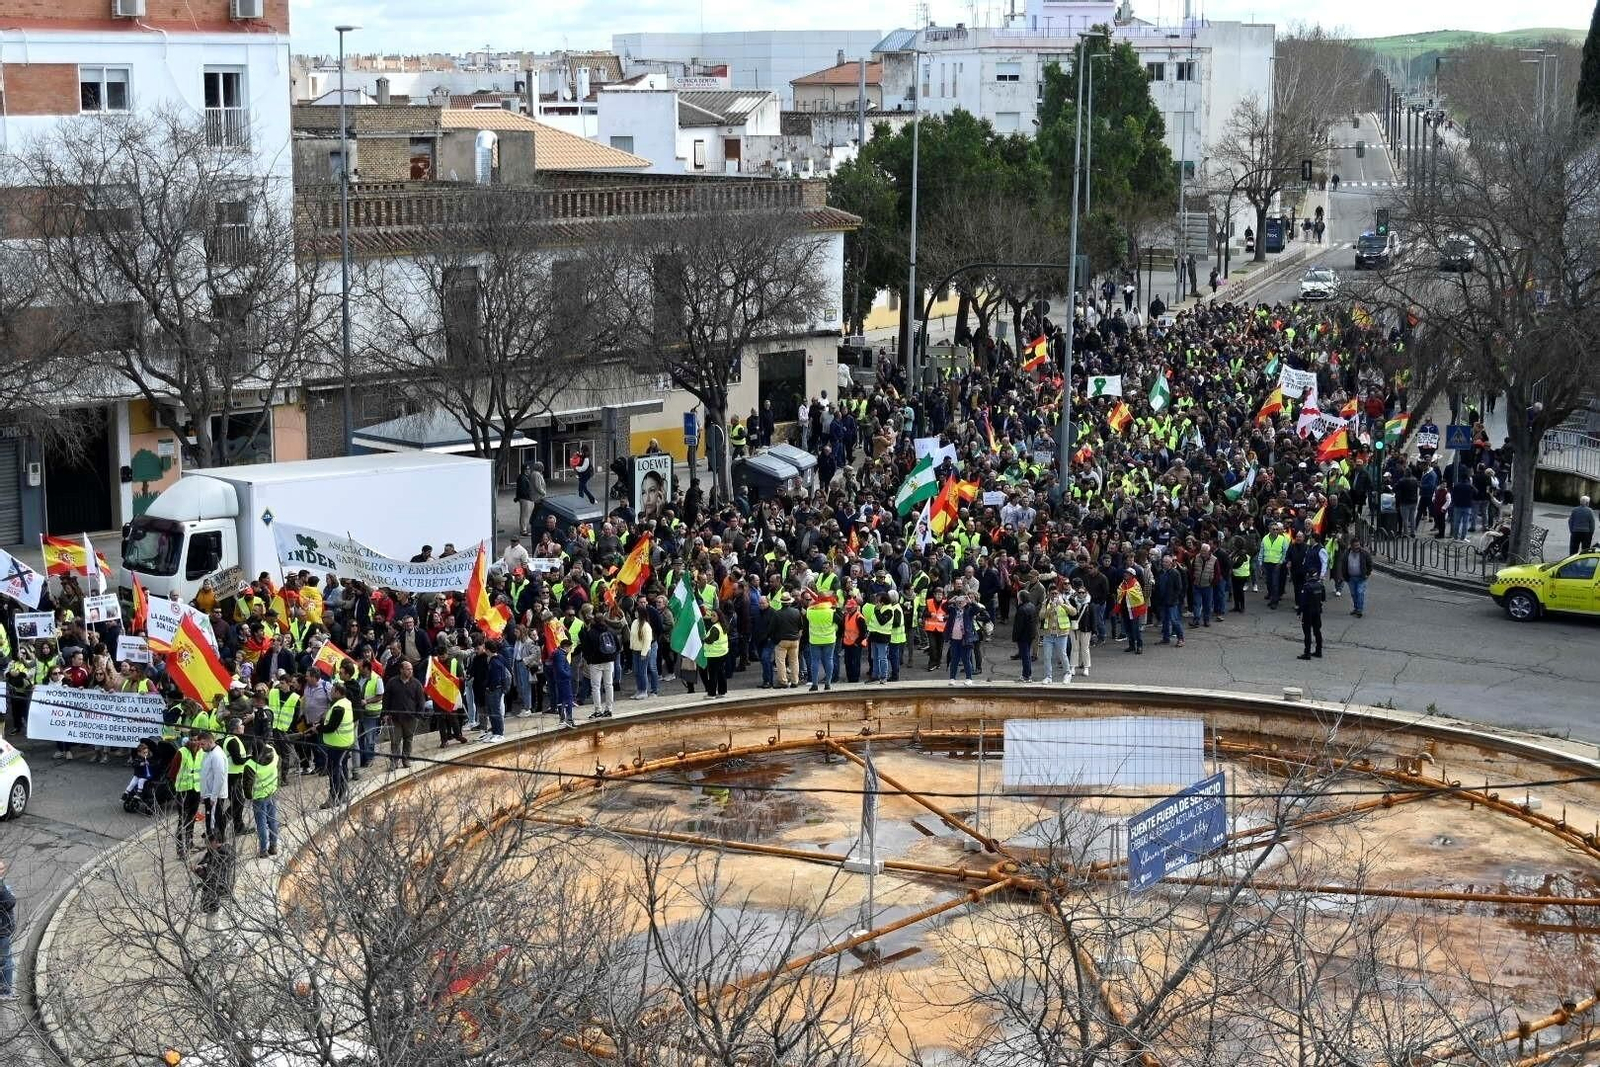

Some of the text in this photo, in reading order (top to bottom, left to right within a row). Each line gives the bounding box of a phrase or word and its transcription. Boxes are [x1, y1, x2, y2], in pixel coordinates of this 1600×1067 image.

[637, 458, 669, 471] LOEWE
[287, 549, 337, 570] INDER
[397, 566, 405, 574] Y
[408, 561, 475, 575] EMPRESARIO
[46, 689, 86, 700] NOSOTROS
[87, 693, 117, 702] VENIMOS
[138, 697, 163, 705] TIERRA
[51, 709, 64, 717] NO
[84, 711, 112, 721] MUERTE
[100, 704, 114, 712] QUE
[128, 706, 139, 714] DA
[152, 708, 163, 716] VID
[50, 719, 159, 734] LOS PEDROCHES DEFENDEMOS
[68, 730, 140, 743] AL SECTOR PRIMARIO
[1130, 814, 1157, 840] FUENTE
[1156, 803, 1179, 825] FUERA
[1179, 796, 1190, 812] DE
